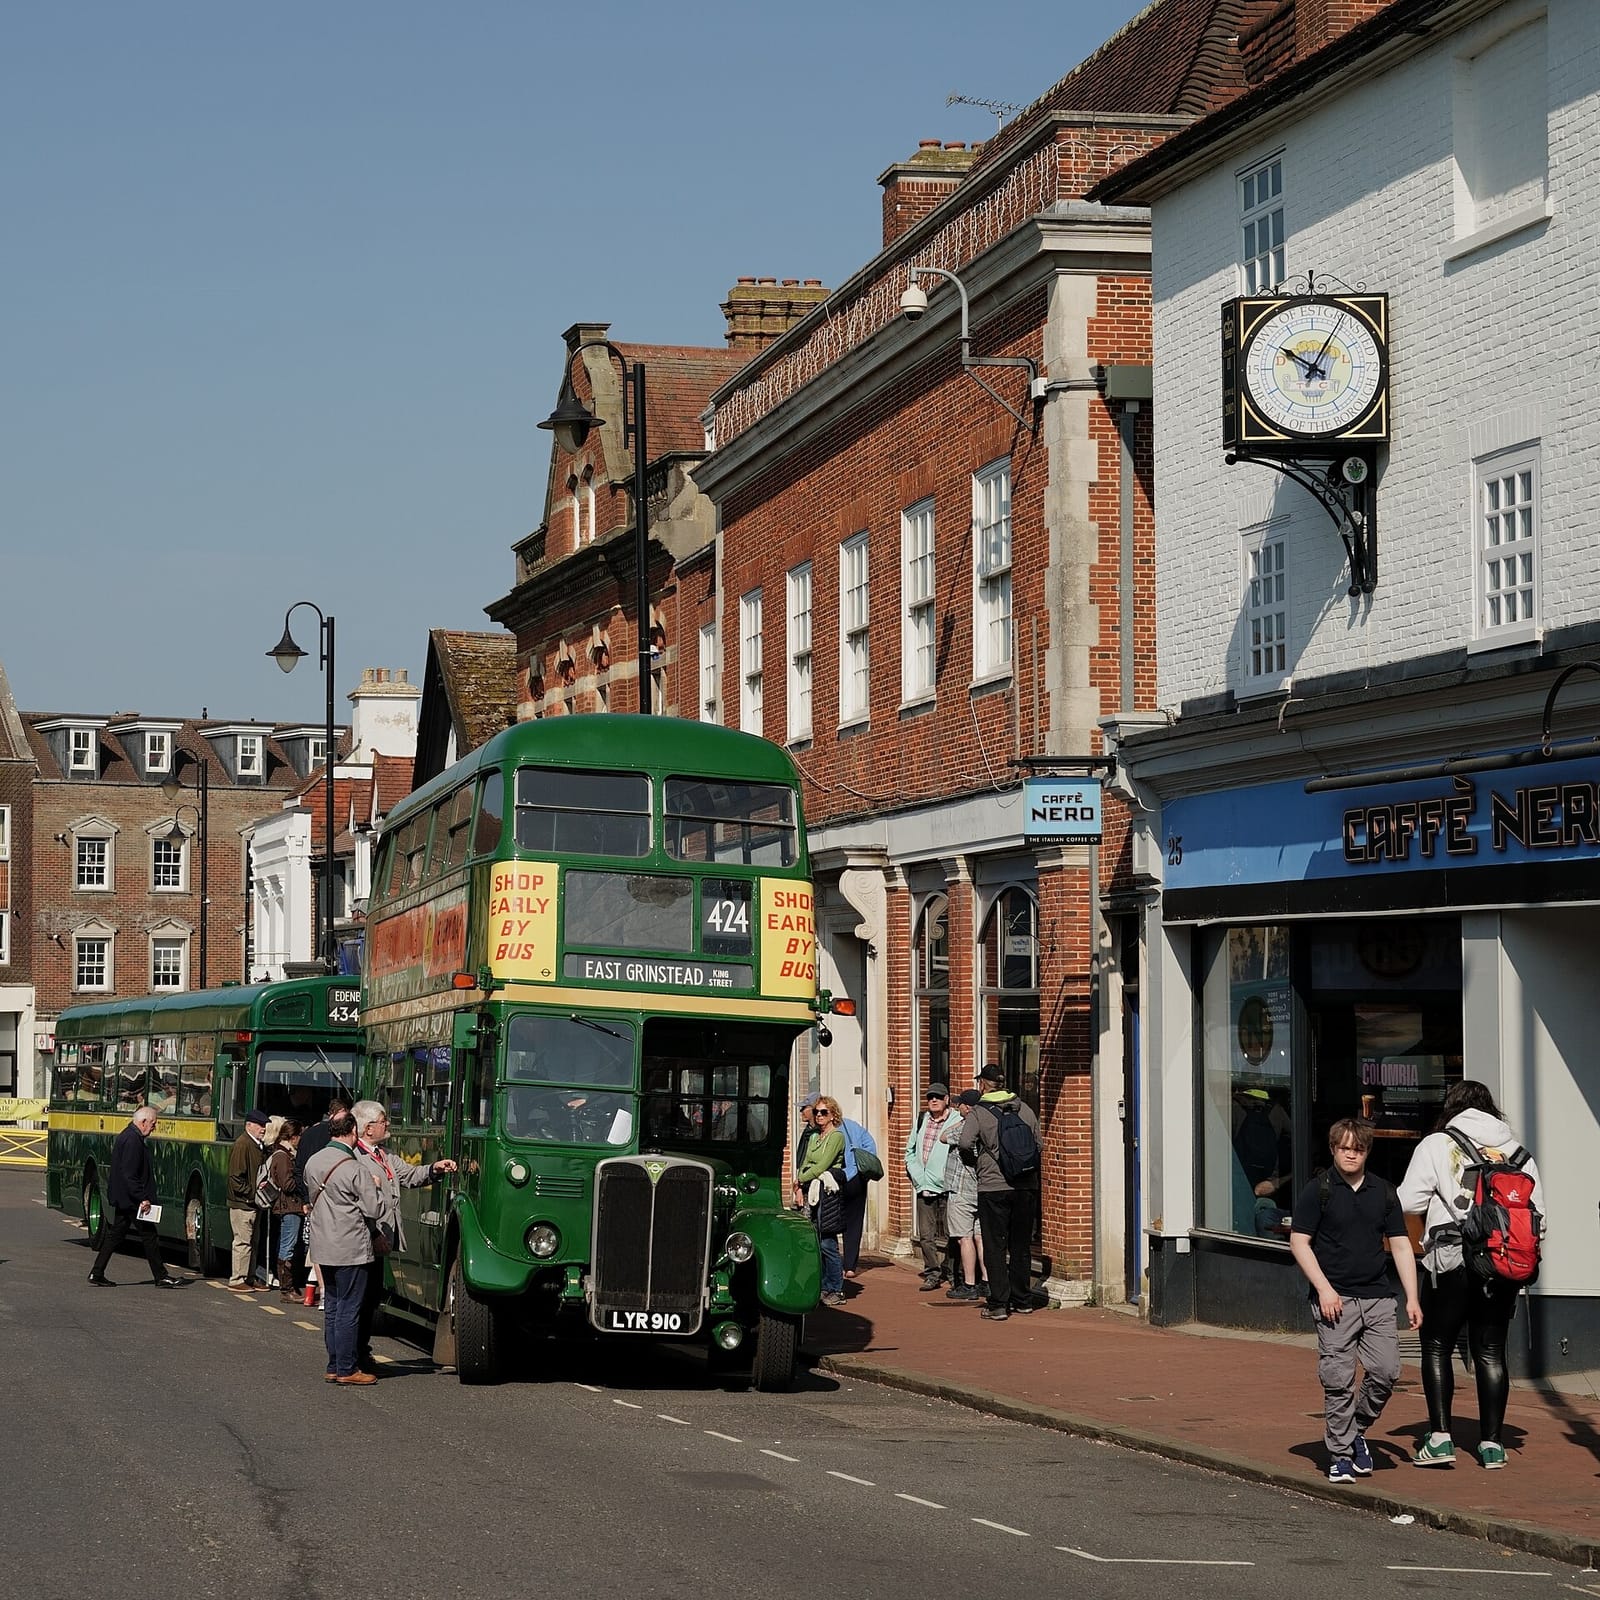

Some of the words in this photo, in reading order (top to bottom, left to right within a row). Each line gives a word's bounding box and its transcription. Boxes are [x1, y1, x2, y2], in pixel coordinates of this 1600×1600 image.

[1250, 320, 1279, 358] TOWN
[1279, 310, 1296, 324] OF
[1248, 364, 1260, 374] 15
[1366, 361, 1379, 372] 72
[1250, 379, 1267, 402] THE
[1261, 401, 1287, 425] SEAL
[1289, 419, 1306, 431] OF
[1308, 421, 1333, 432] THE
[1334, 377, 1377, 426] BOROUGH
[1042, 792, 1083, 804] CAFFÈ
[1032, 807, 1094, 822] NERO
[1343, 775, 1477, 863] CAFFÈ
[1491, 783, 1600, 849] NER
[1168, 836, 1182, 866] 25
[495, 874, 544, 892] SHOP
[491, 897, 550, 917] EARLY
[707, 900, 749, 933] 424
[501, 919, 531, 936] BY
[496, 943, 535, 960] BUS
[786, 938, 812, 955] BY
[585, 961, 621, 980] EAST
[626, 964, 704, 986] GRINSTEAD
[712, 969, 729, 978] KING
[780, 961, 815, 980] BUS
[708, 978, 733, 988] STREET
[328, 1006, 360, 1022] 434
[1362, 1062, 1419, 1087] COLOMBIA
[612, 1311, 648, 1329] LYR
[651, 1313, 681, 1330] 910
